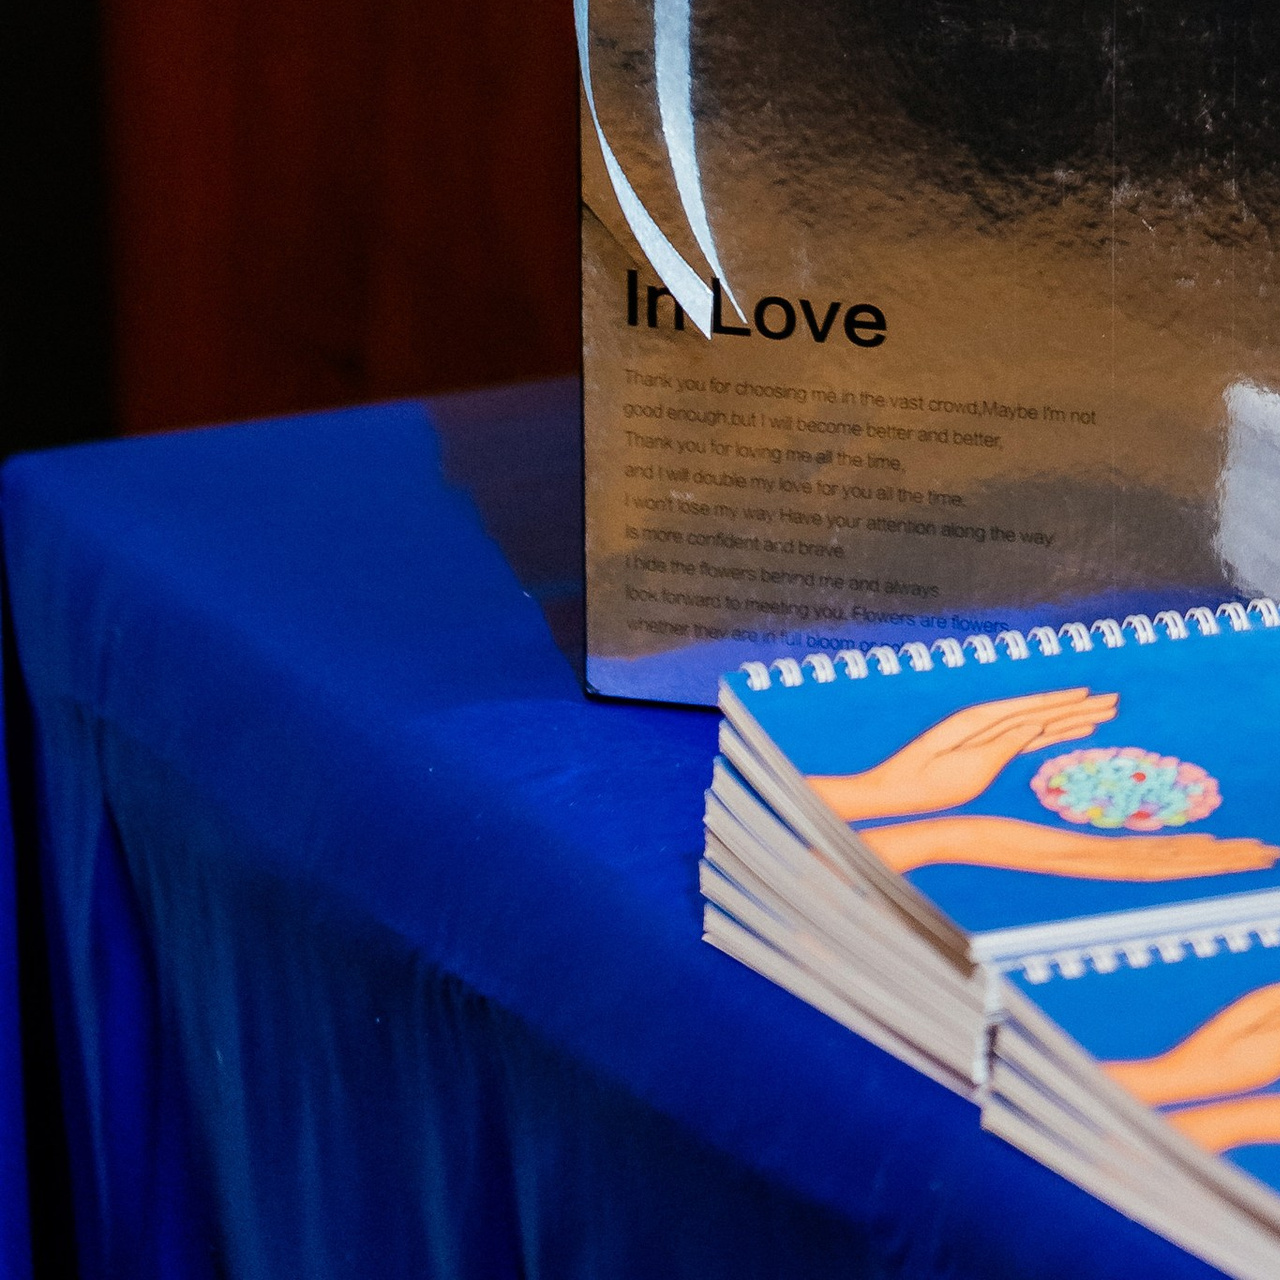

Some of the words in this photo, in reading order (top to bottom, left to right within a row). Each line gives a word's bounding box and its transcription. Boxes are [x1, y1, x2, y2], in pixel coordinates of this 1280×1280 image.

[626, 269, 685, 331] In
[711, 277, 888, 348] Love
[624, 369, 672, 388] Thank
[676, 377, 706, 393] you
[710, 377, 730, 394] for
[735, 381, 807, 404] choosing
[811, 389, 837, 403] me
[842, 391, 856, 405] in
[860, 391, 885, 408] the
[889, 395, 924, 411] vast
[1042, 405, 1066, 422] I'm
[1070, 409, 1096, 425] not
[623, 403, 662, 418] good
[771, 416, 792, 428] will
[797, 417, 862, 437] become
[866, 423, 912, 441] better
[917, 428, 949, 444] and
[624, 430, 672, 449] Thank
[677, 439, 706, 454] you
[711, 439, 731, 455] for
[736, 443, 781, 463] loving
[786, 450, 811, 463] me
[815, 449, 833, 464] all
[837, 452, 863, 467] the
[624, 464, 653, 479] and
[667, 468, 689, 481] will
[693, 471, 747, 488] double
[750, 478, 775, 492] my
[779, 478, 812, 494] love
[817, 480, 838, 496] for
[843, 482, 871, 502] you
[875, 485, 893, 501] all
[897, 487, 923, 505] the
[643, 527, 683, 542] more
[686, 532, 759, 551] confident
[764, 539, 794, 553] and
[678, 500, 711, 516] lose
[714, 506, 738, 519] my
[780, 508, 821, 526] Have
[826, 513, 860, 530] your
[866, 517, 935, 535] attention
[941, 524, 985, 542] along
[990, 526, 1016, 542] the
[634, 556, 667, 573] hide
[671, 560, 695, 575] the
[700, 561, 756, 581] flowers
[760, 567, 814, 587] behind
[819, 575, 844, 589] me
[849, 578, 879, 593] and
[884, 581, 940, 598] always
[625, 585, 657, 602] look
[661, 588, 720, 609] forward
[725, 597, 741, 610] to
[745, 599, 809, 620] meeting
[853, 605, 916, 626] Flowers
[920, 614, 947, 628] are
[627, 618, 689, 635] whether
[806, 634, 855, 650] bloom
